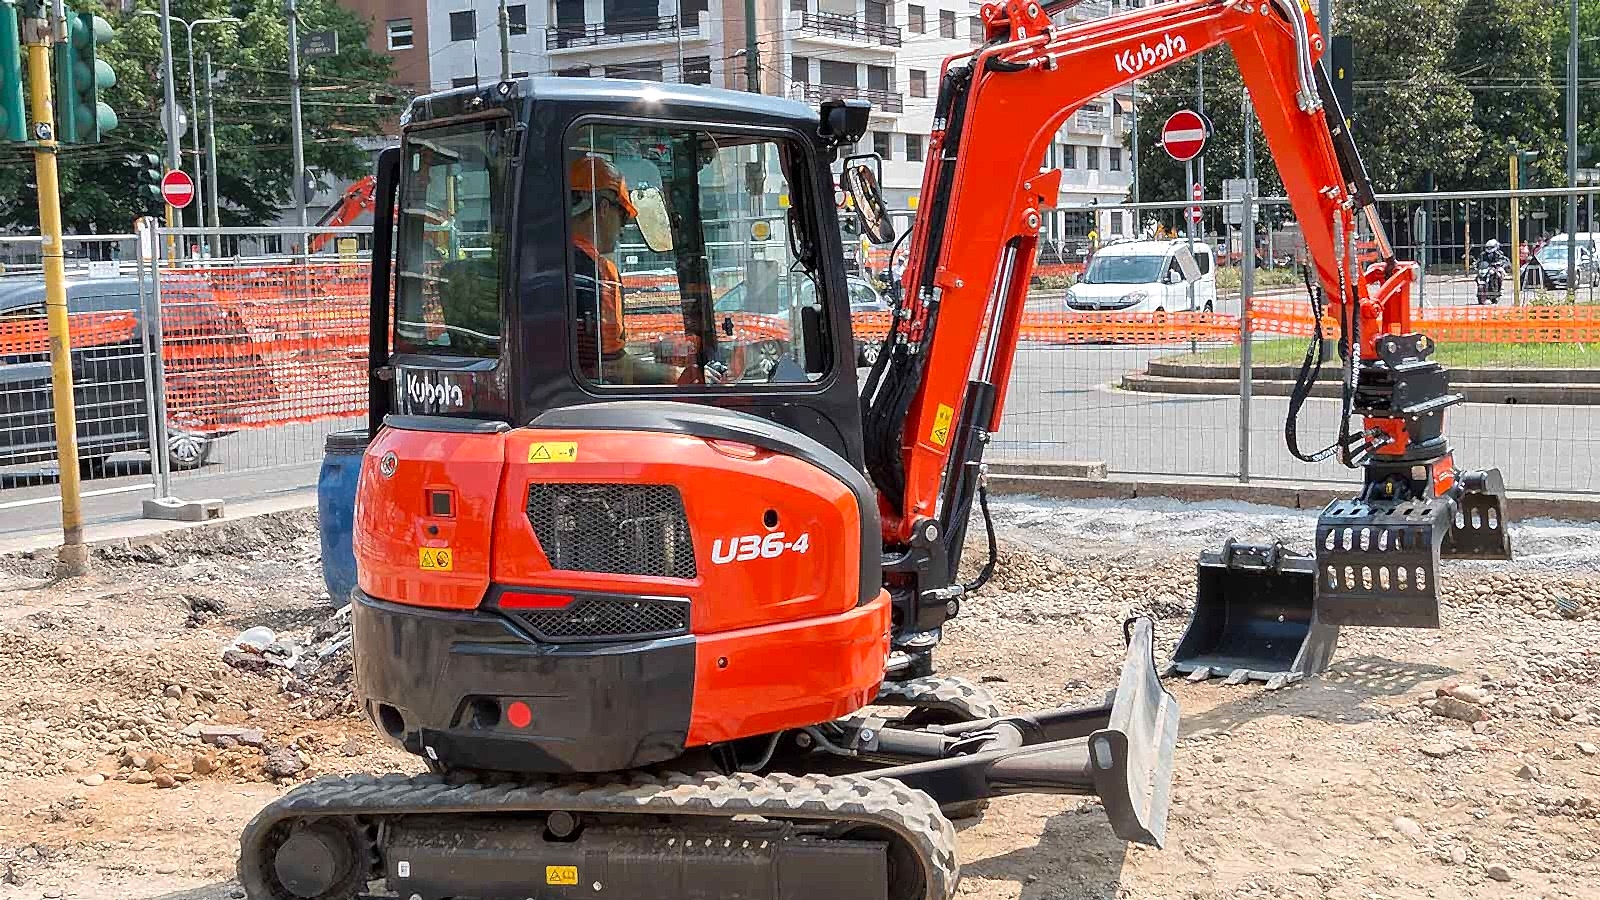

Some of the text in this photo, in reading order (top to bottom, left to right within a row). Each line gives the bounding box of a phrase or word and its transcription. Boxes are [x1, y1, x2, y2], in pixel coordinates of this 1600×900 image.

[1114, 32, 1187, 75] Kubota
[407, 373, 464, 407] Kubota
[711, 531, 809, 564] U36-4
